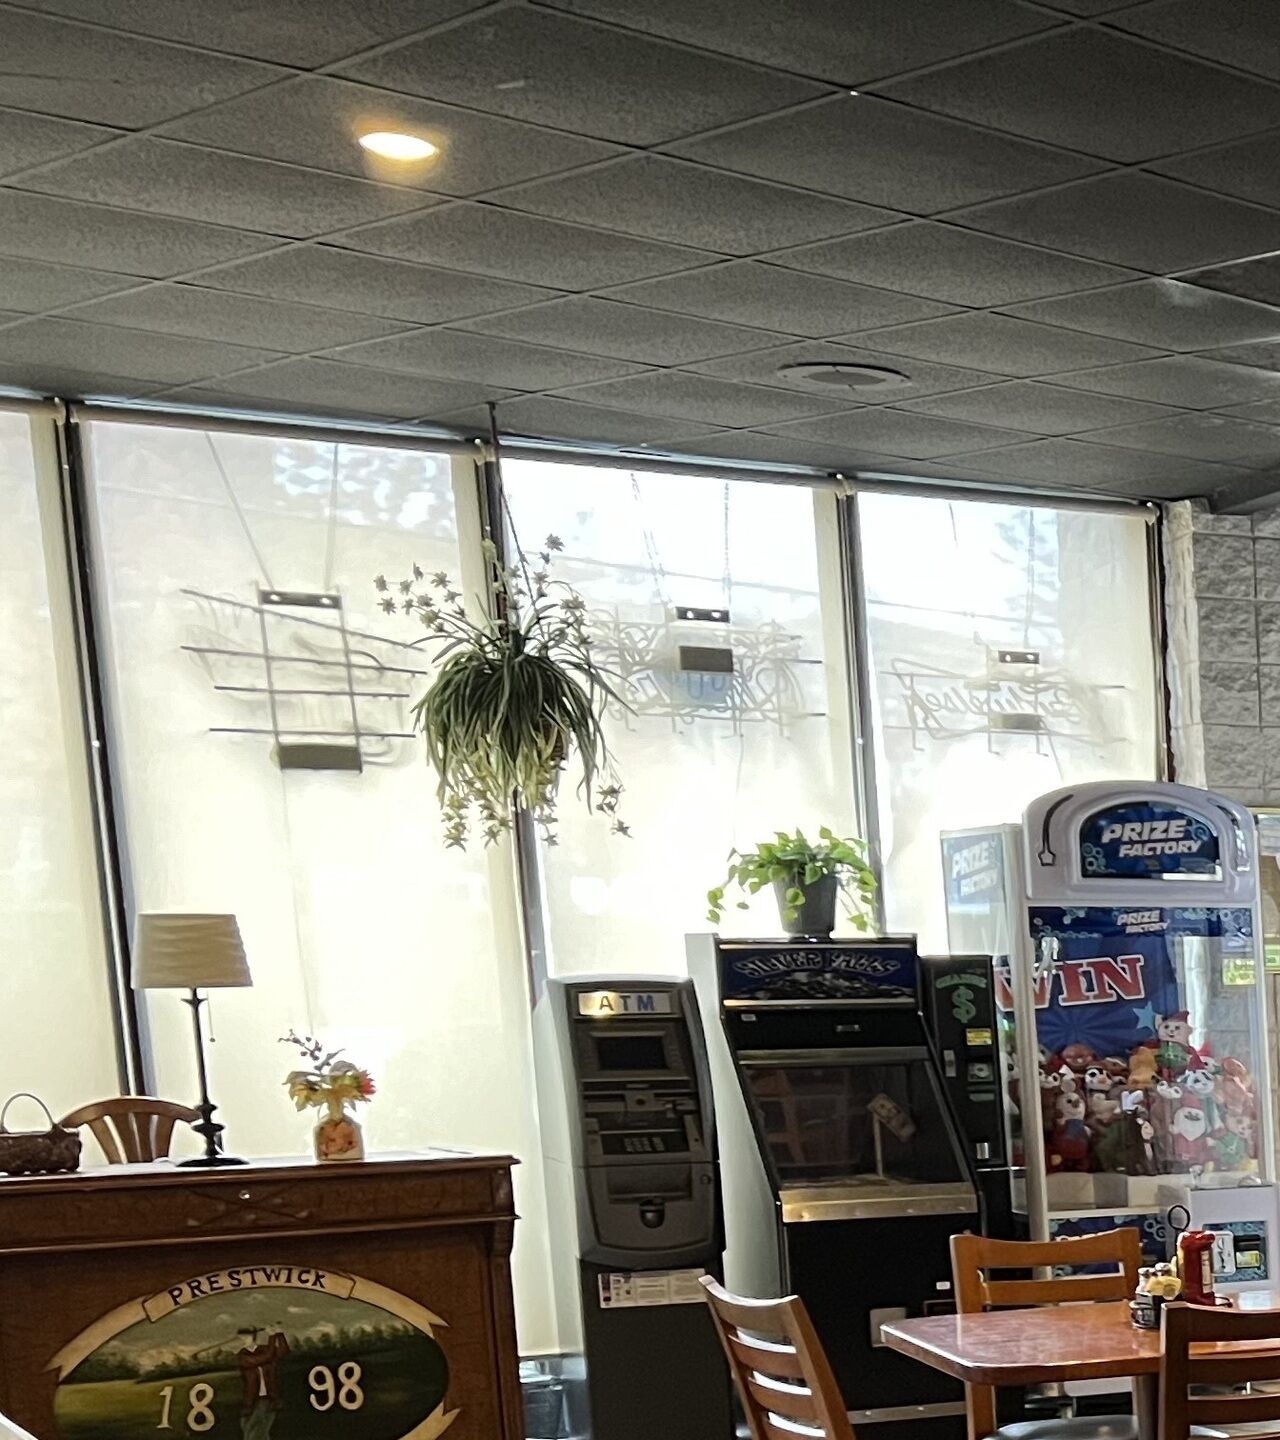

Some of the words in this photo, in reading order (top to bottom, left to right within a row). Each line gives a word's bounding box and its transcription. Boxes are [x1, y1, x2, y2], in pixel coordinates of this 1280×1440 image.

[1102, 819, 1189, 843] PRIZE
[951, 840, 990, 880] PRIZE
[1118, 839, 1202, 858] FACTORY
[1116, 909, 1162, 926] PRIZE
[993, 954, 1145, 1012] WIN
[599, 994, 655, 1012] ATM
[168, 1266, 327, 1306] PRESTWICK
[157, 1383, 215, 1432] 18
[308, 1361, 365, 1411] 98
